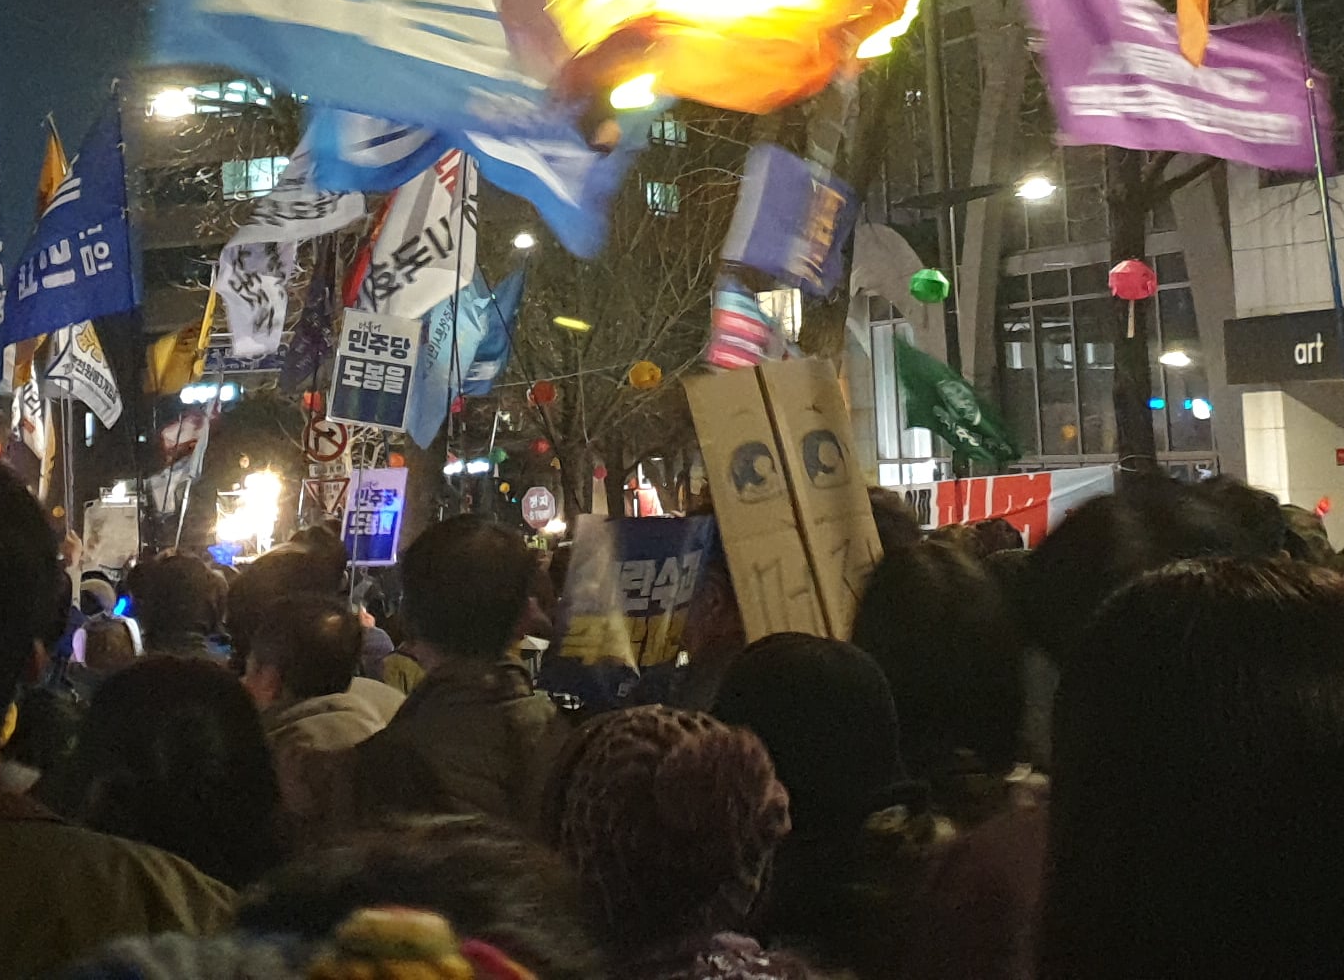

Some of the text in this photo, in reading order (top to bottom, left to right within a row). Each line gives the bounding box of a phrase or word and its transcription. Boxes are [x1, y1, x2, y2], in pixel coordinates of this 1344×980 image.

[348, 328, 411, 360] 민주당
[1294, 333, 1324, 366] art
[341, 359, 406, 395] 도봉을
